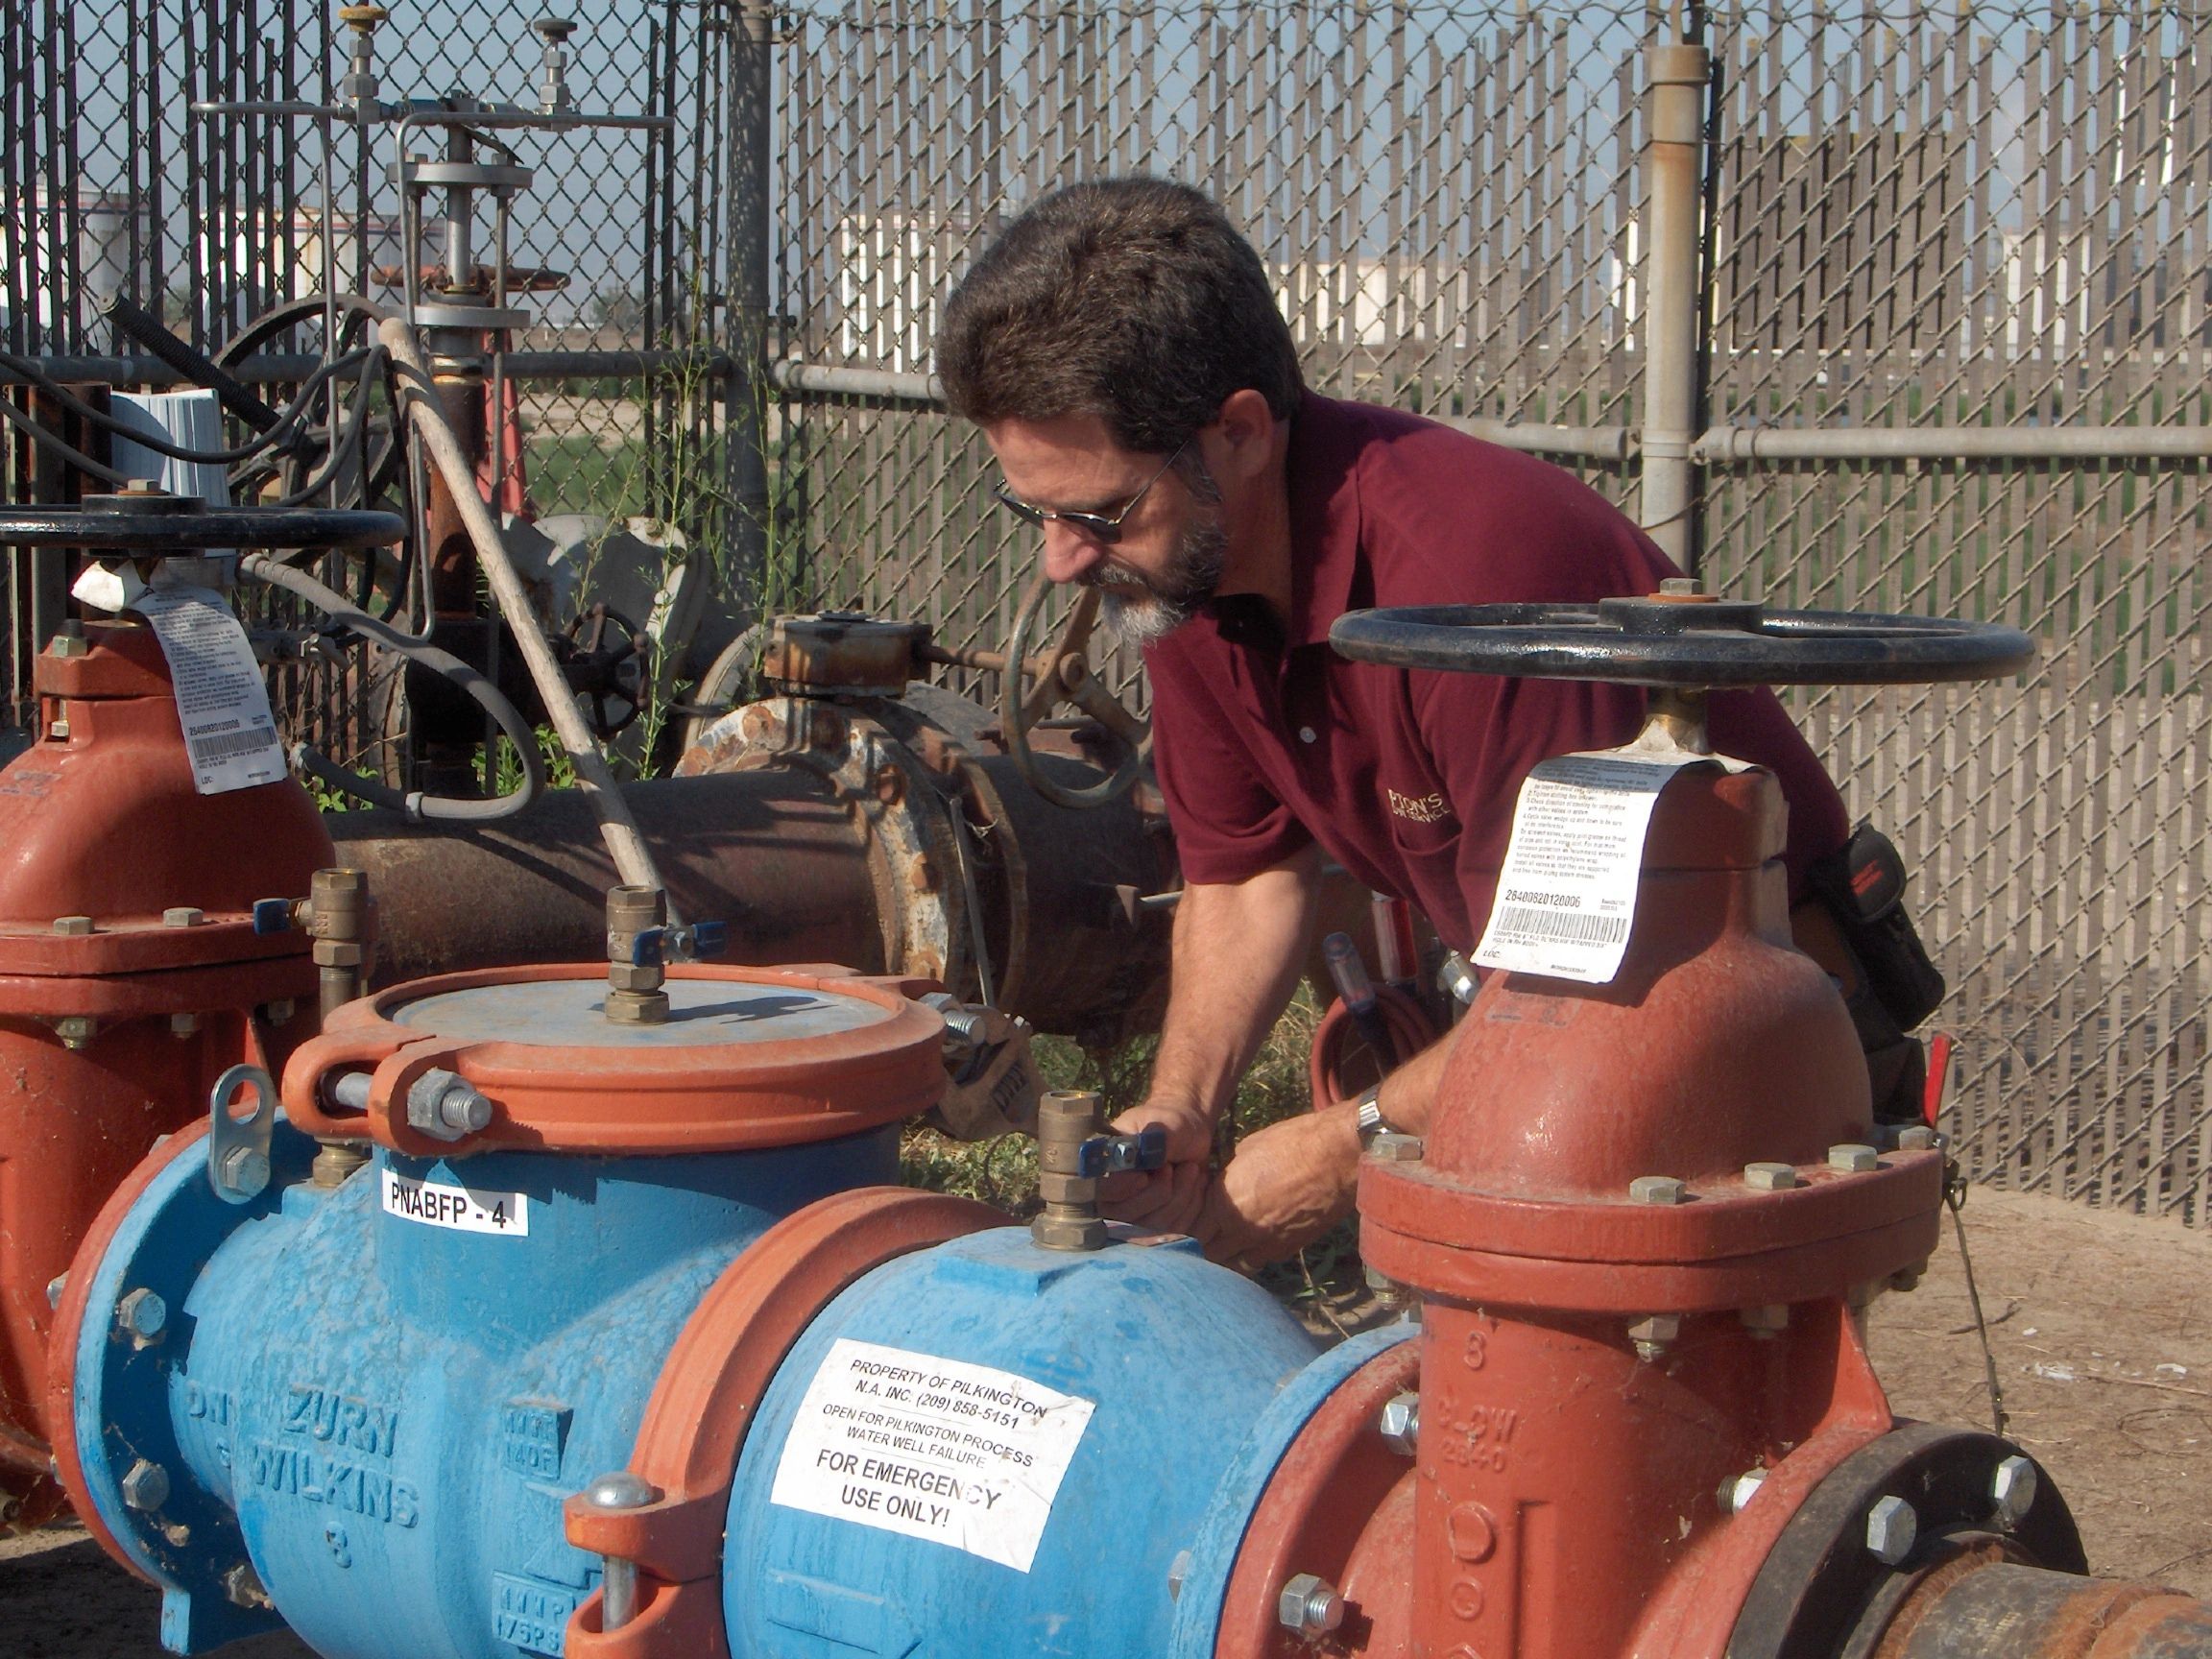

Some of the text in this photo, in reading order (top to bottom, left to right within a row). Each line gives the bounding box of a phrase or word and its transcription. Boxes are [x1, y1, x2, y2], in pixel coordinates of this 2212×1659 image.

[392, 1181, 468, 1223] PNABFP
[492, 1200, 507, 1229] 4
[850, 1358, 1047, 1419] PROPERTY OF PILKINGTON
[854, 1379, 1020, 1430] N.A. INC. (209) 858-5151
[285, 1389, 399, 1458] ZURN
[823, 1403, 1035, 1467] OPEN FOR PILKINGTON PROCESS
[846, 1426, 988, 1469] WATER WELL FAILURE
[252, 1443, 421, 1530] WILKINS
[816, 1448, 1002, 1511] FOR EMERGENCY
[841, 1483, 951, 1528] USE ONLY!
